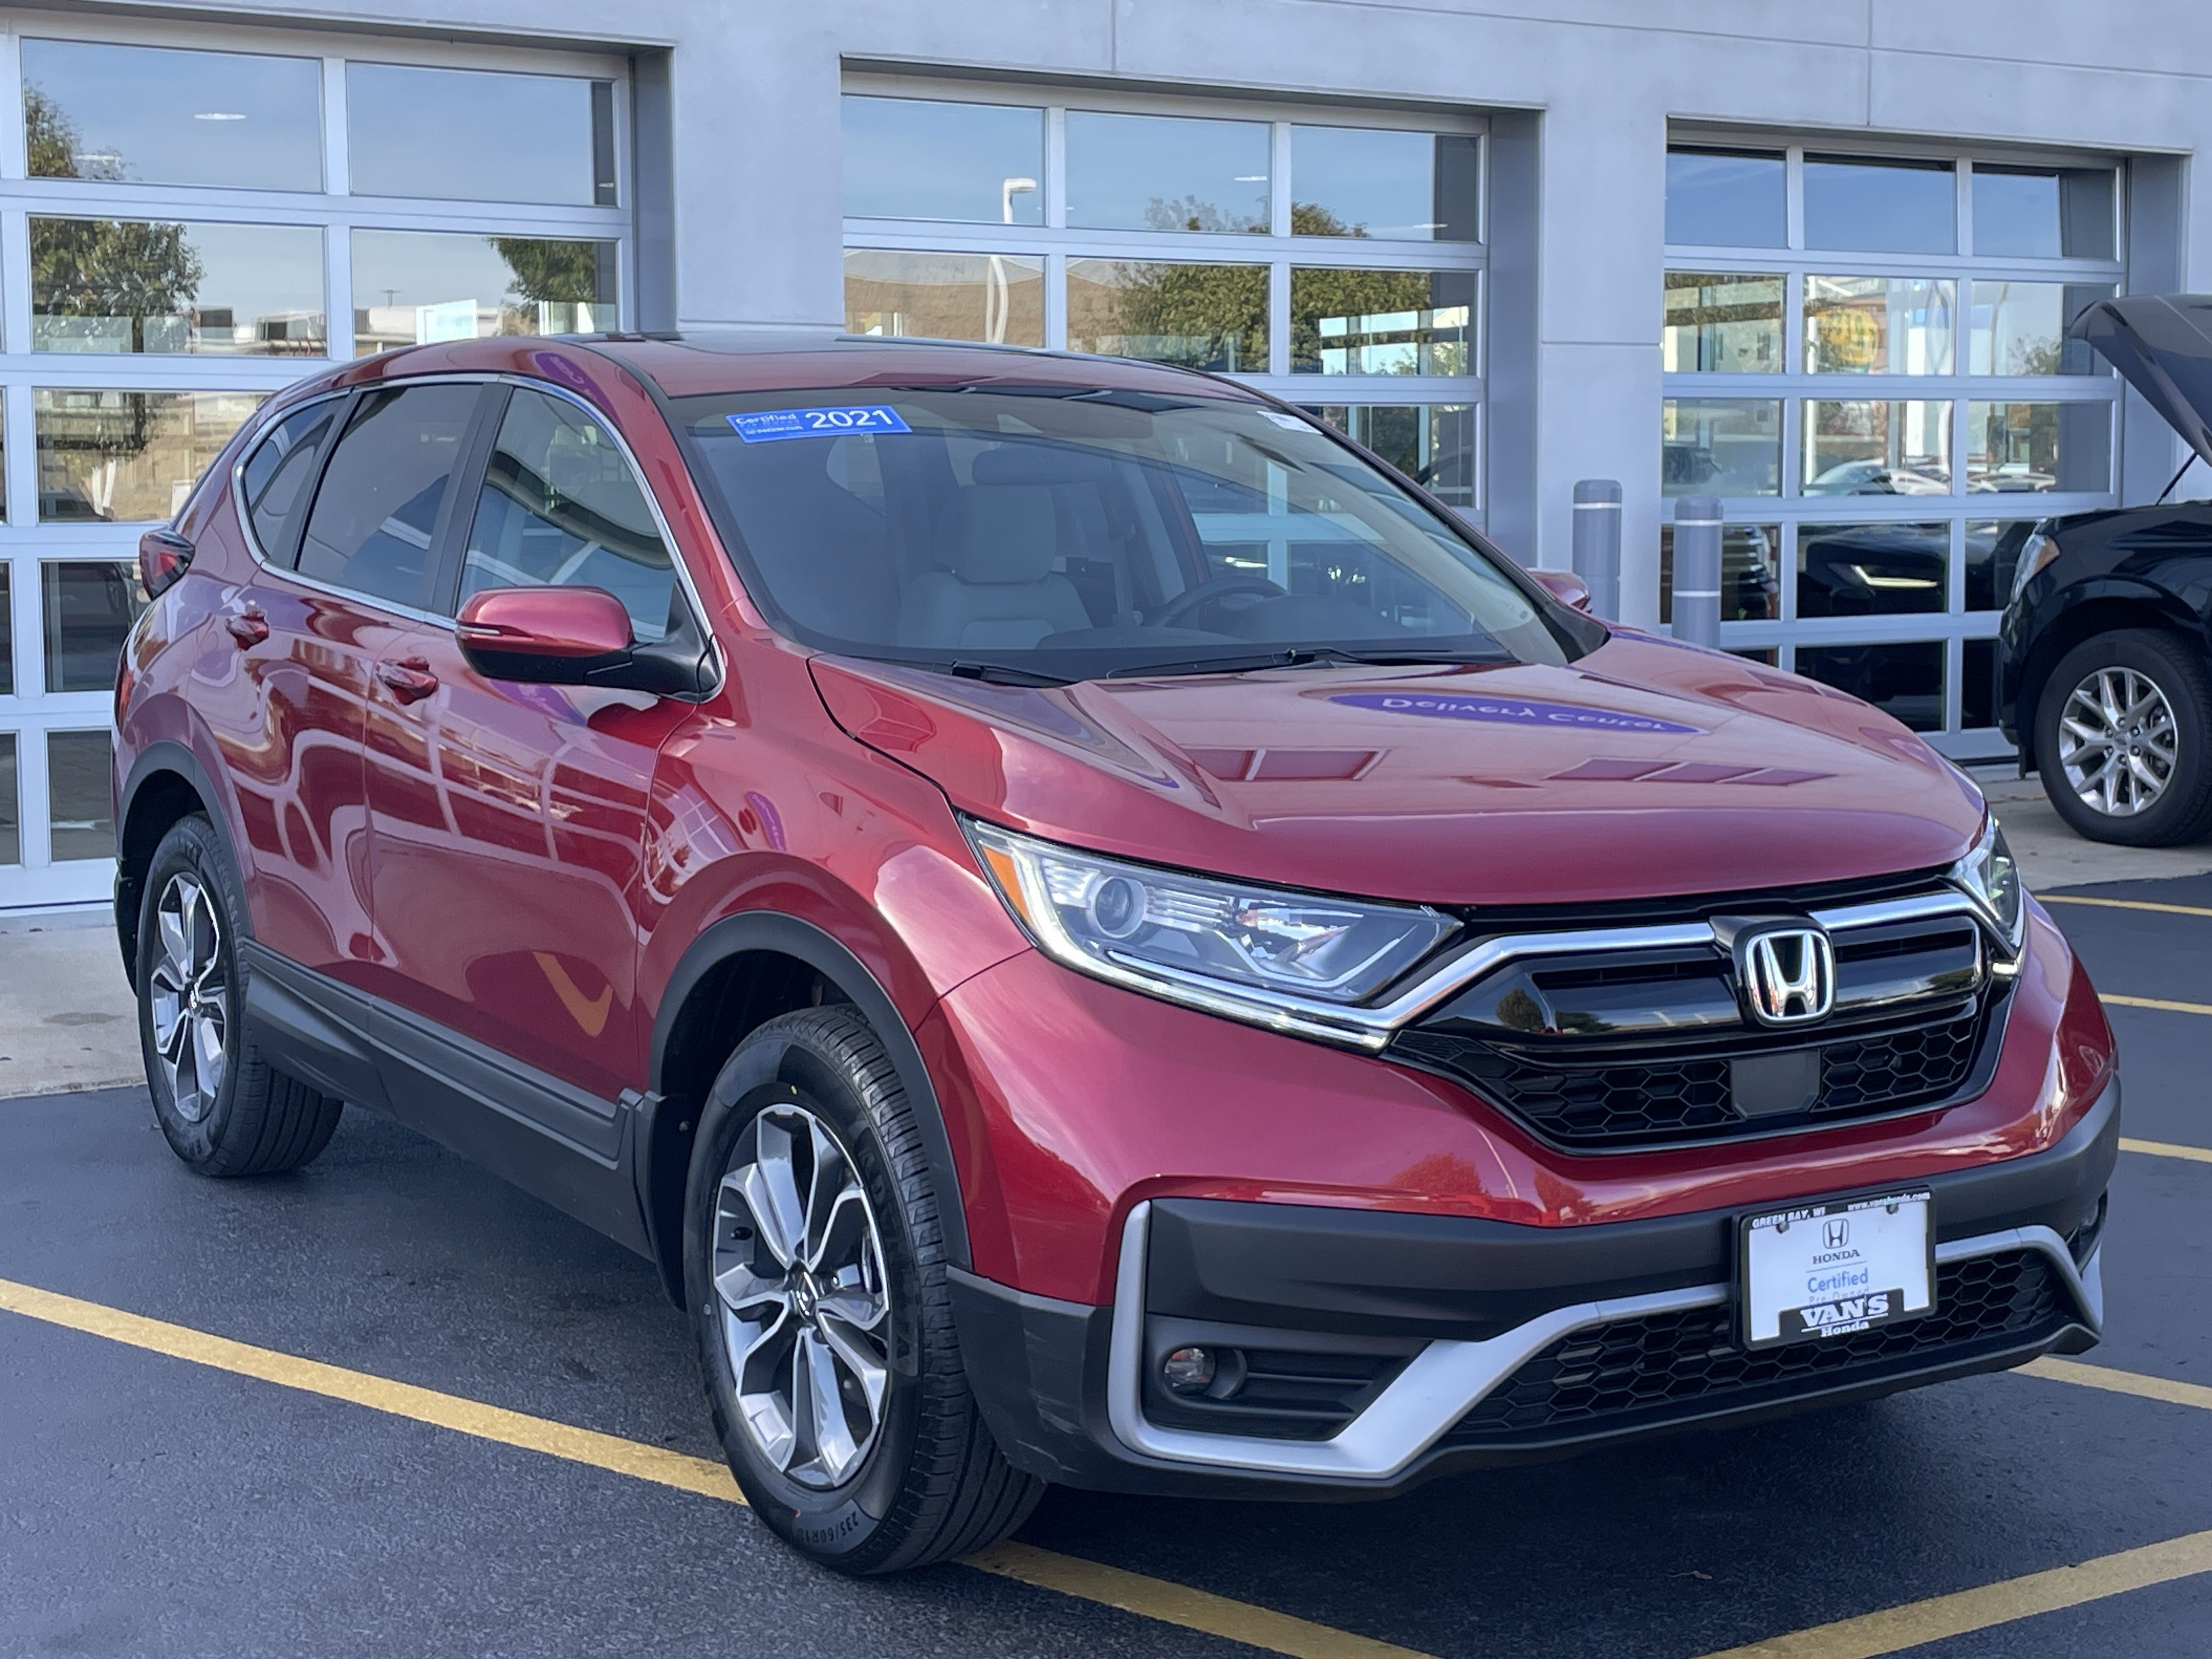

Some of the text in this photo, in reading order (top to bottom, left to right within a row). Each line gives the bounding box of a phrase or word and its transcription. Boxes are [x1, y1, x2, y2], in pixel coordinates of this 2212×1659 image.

[736, 413, 797, 425] Certified
[804, 409, 894, 429] 2021
[1812, 1249, 1861, 1264] HONDA
[1807, 1267, 1869, 1294] Certified
[1820, 1319, 1870, 1338] Honda
